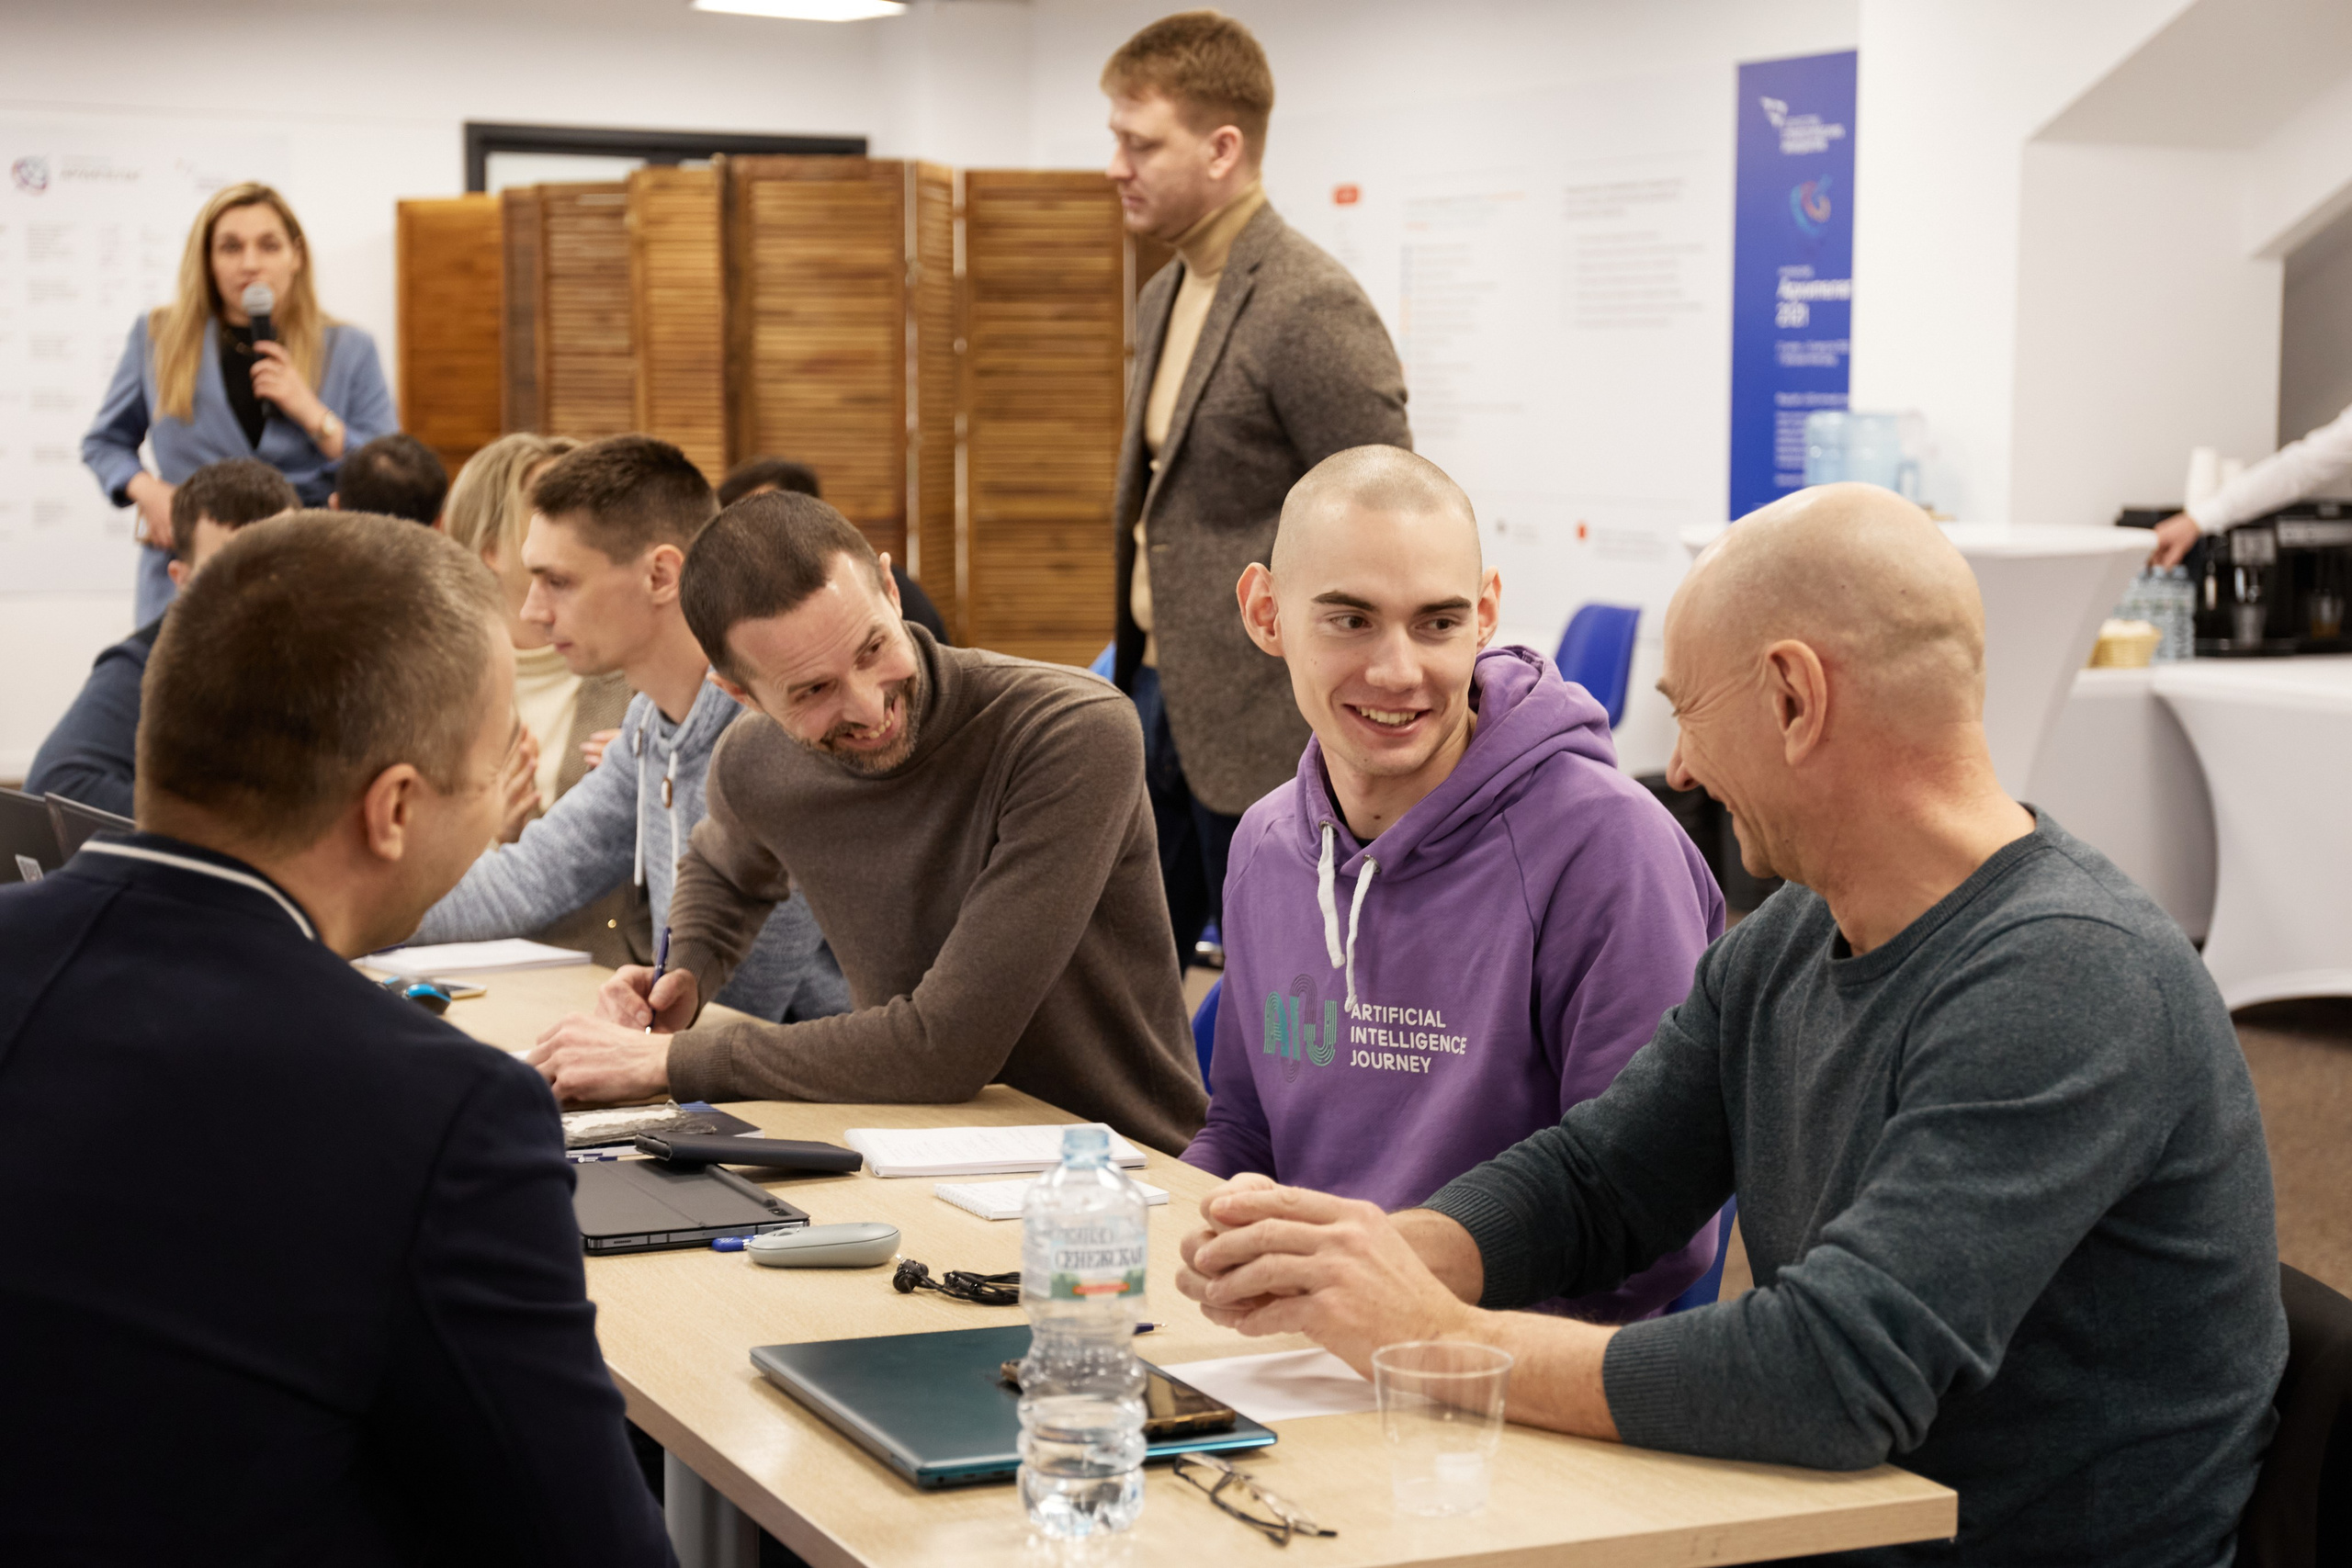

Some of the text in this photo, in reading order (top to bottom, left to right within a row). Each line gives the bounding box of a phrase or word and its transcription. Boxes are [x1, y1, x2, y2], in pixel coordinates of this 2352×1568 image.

[1351, 1004, 1446, 1028] ARTIFICIAL
[1350, 1026, 1467, 1055] INTELLIGENCE
[1350, 1050, 1431, 1074] JOURNEY
